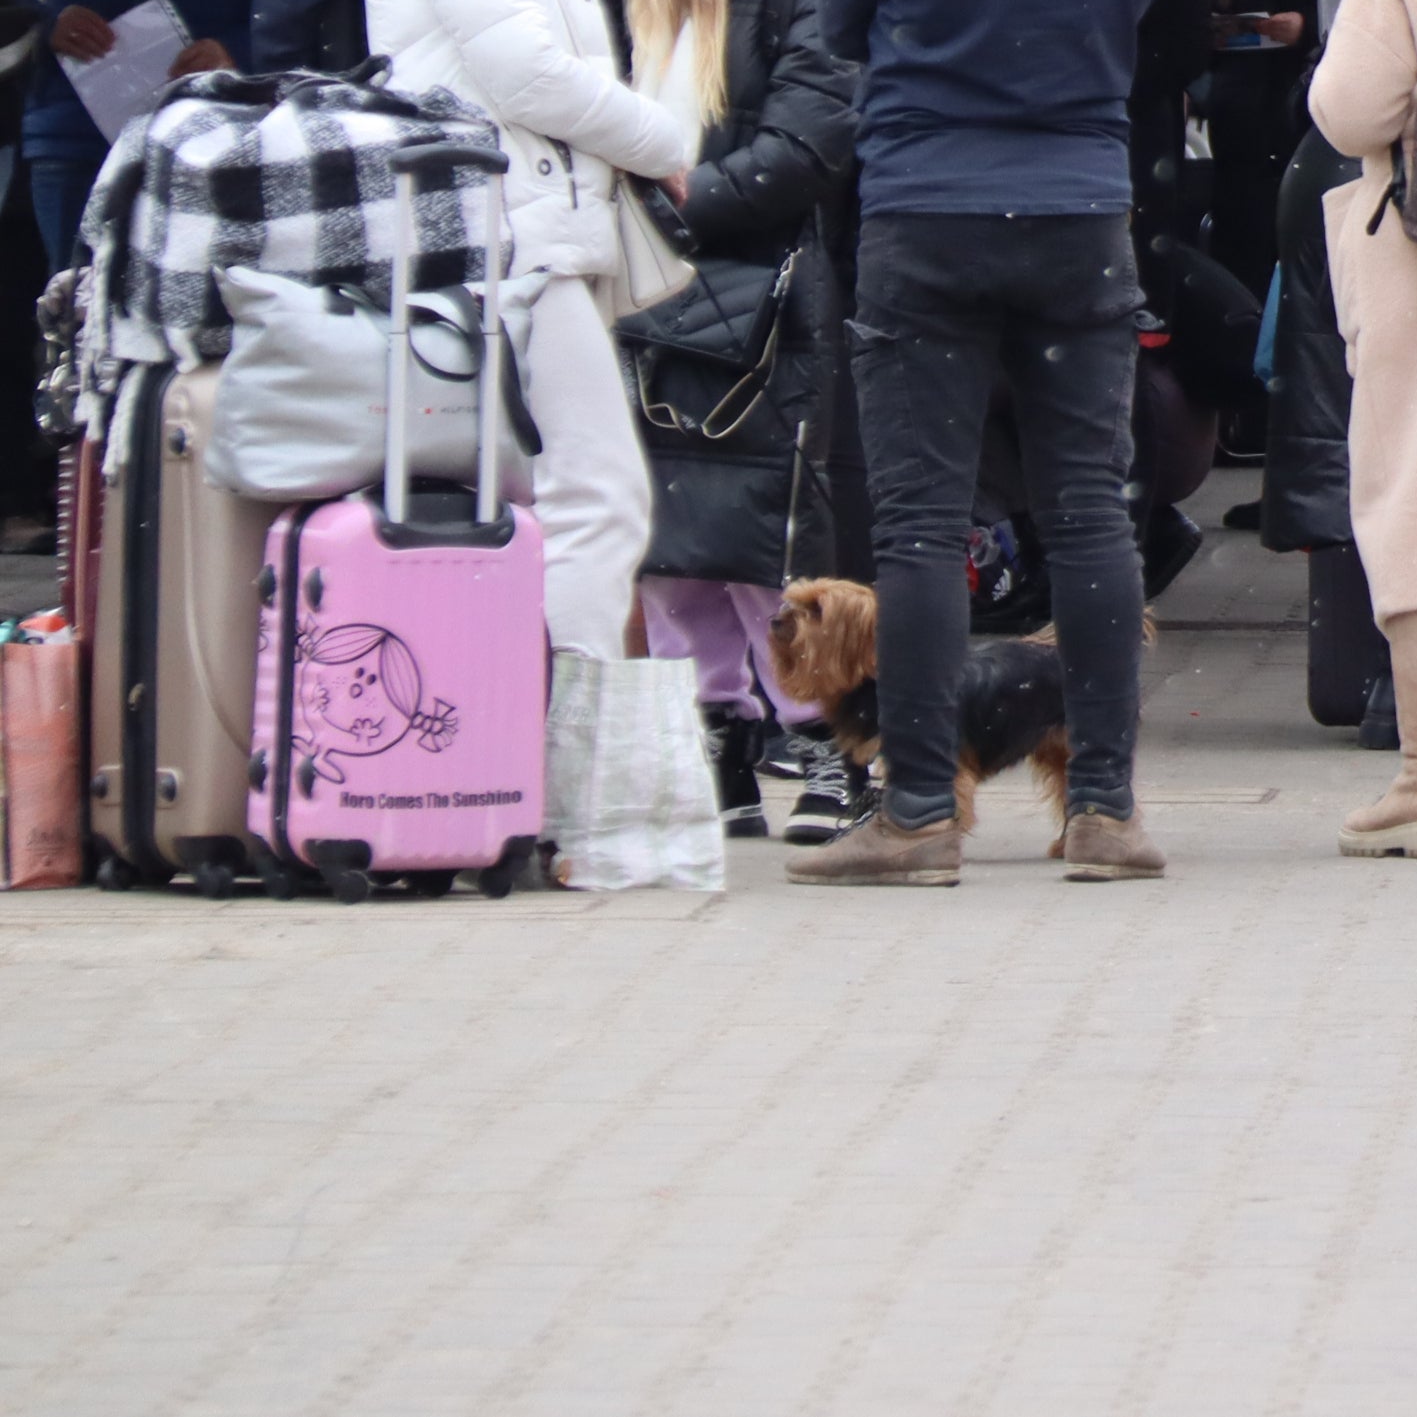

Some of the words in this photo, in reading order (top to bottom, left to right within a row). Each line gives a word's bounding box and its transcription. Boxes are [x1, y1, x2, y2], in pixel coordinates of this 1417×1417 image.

[378, 793, 423, 809] Comes
[426, 793, 449, 809] The
[452, 790, 522, 807] Sunshine
